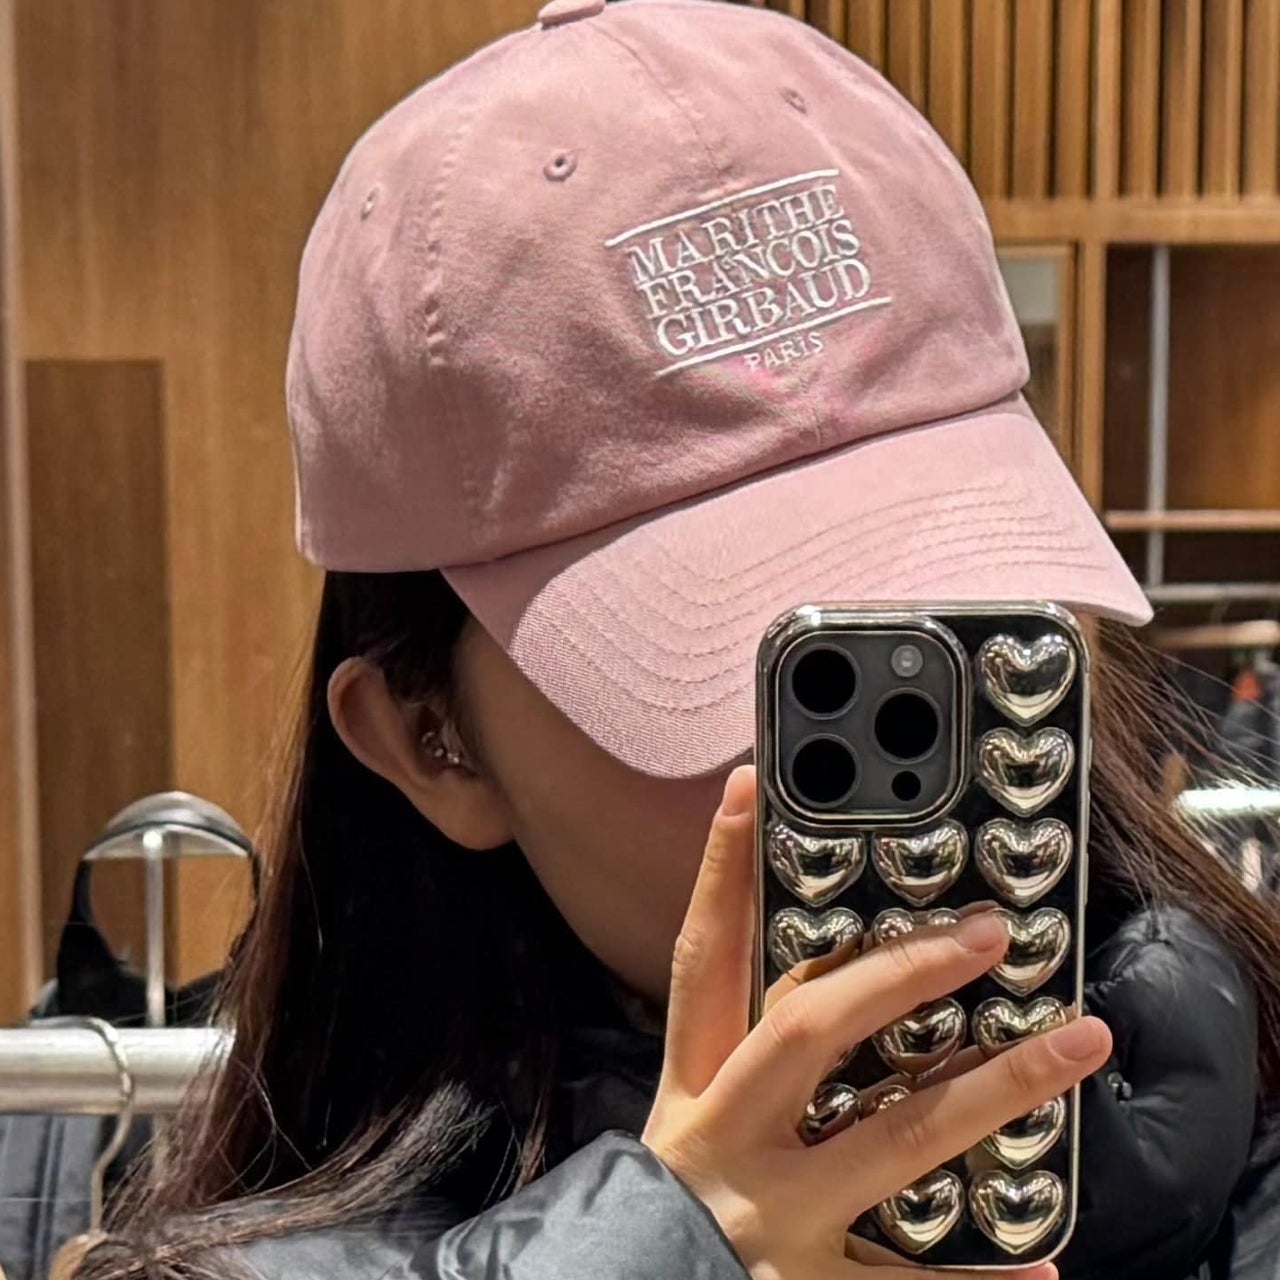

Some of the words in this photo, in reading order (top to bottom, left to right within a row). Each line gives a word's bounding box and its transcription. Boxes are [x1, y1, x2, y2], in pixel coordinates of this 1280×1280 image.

[626, 184, 845, 284] MARITHE
[656, 258, 872, 356] GIRBAUD
[743, 330, 824, 373] PARIS
